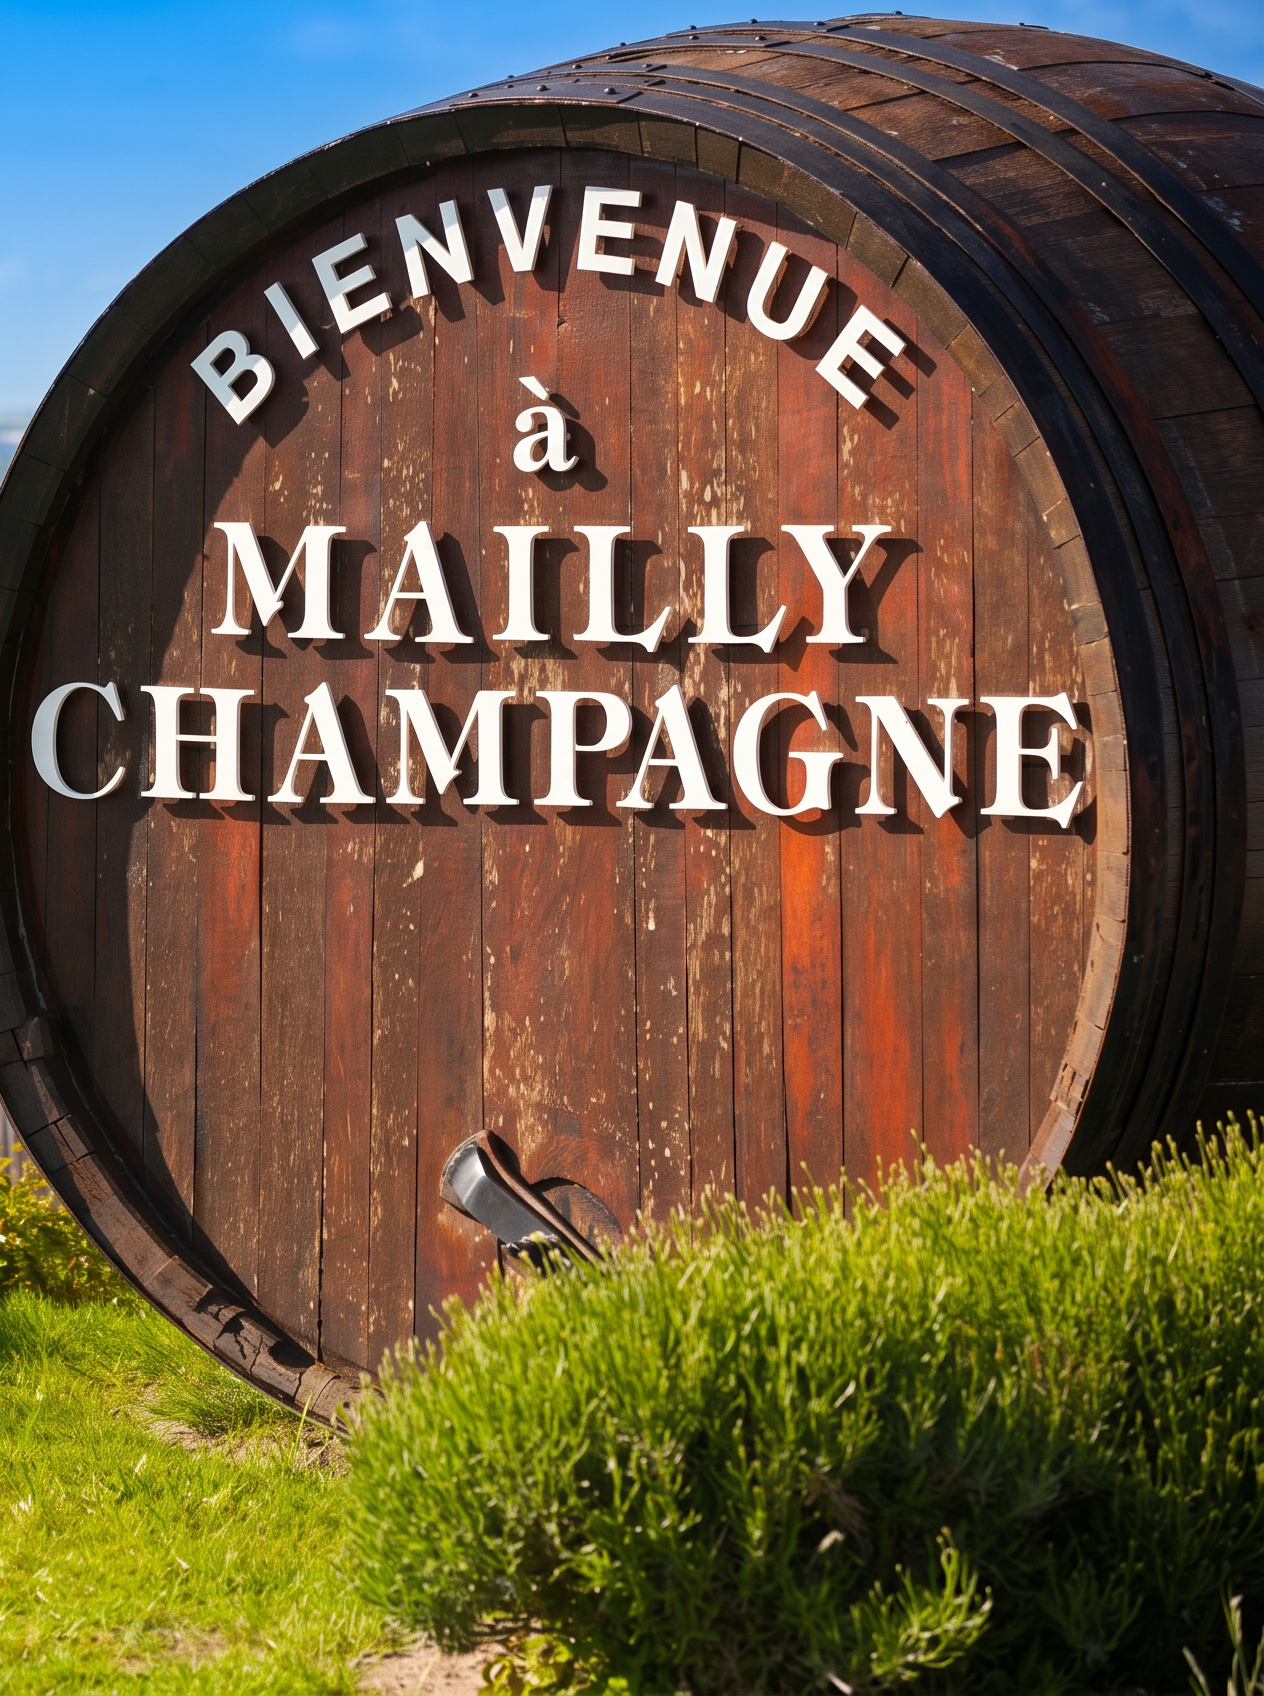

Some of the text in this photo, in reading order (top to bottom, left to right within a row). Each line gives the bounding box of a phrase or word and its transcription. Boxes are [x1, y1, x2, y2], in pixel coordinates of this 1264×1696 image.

[191, 185, 905, 426] BIENVENUE
[513, 376, 579, 473] à
[211, 521, 891, 654] MAILLY
[31, 681, 1085, 829] CHAMPAGNE
